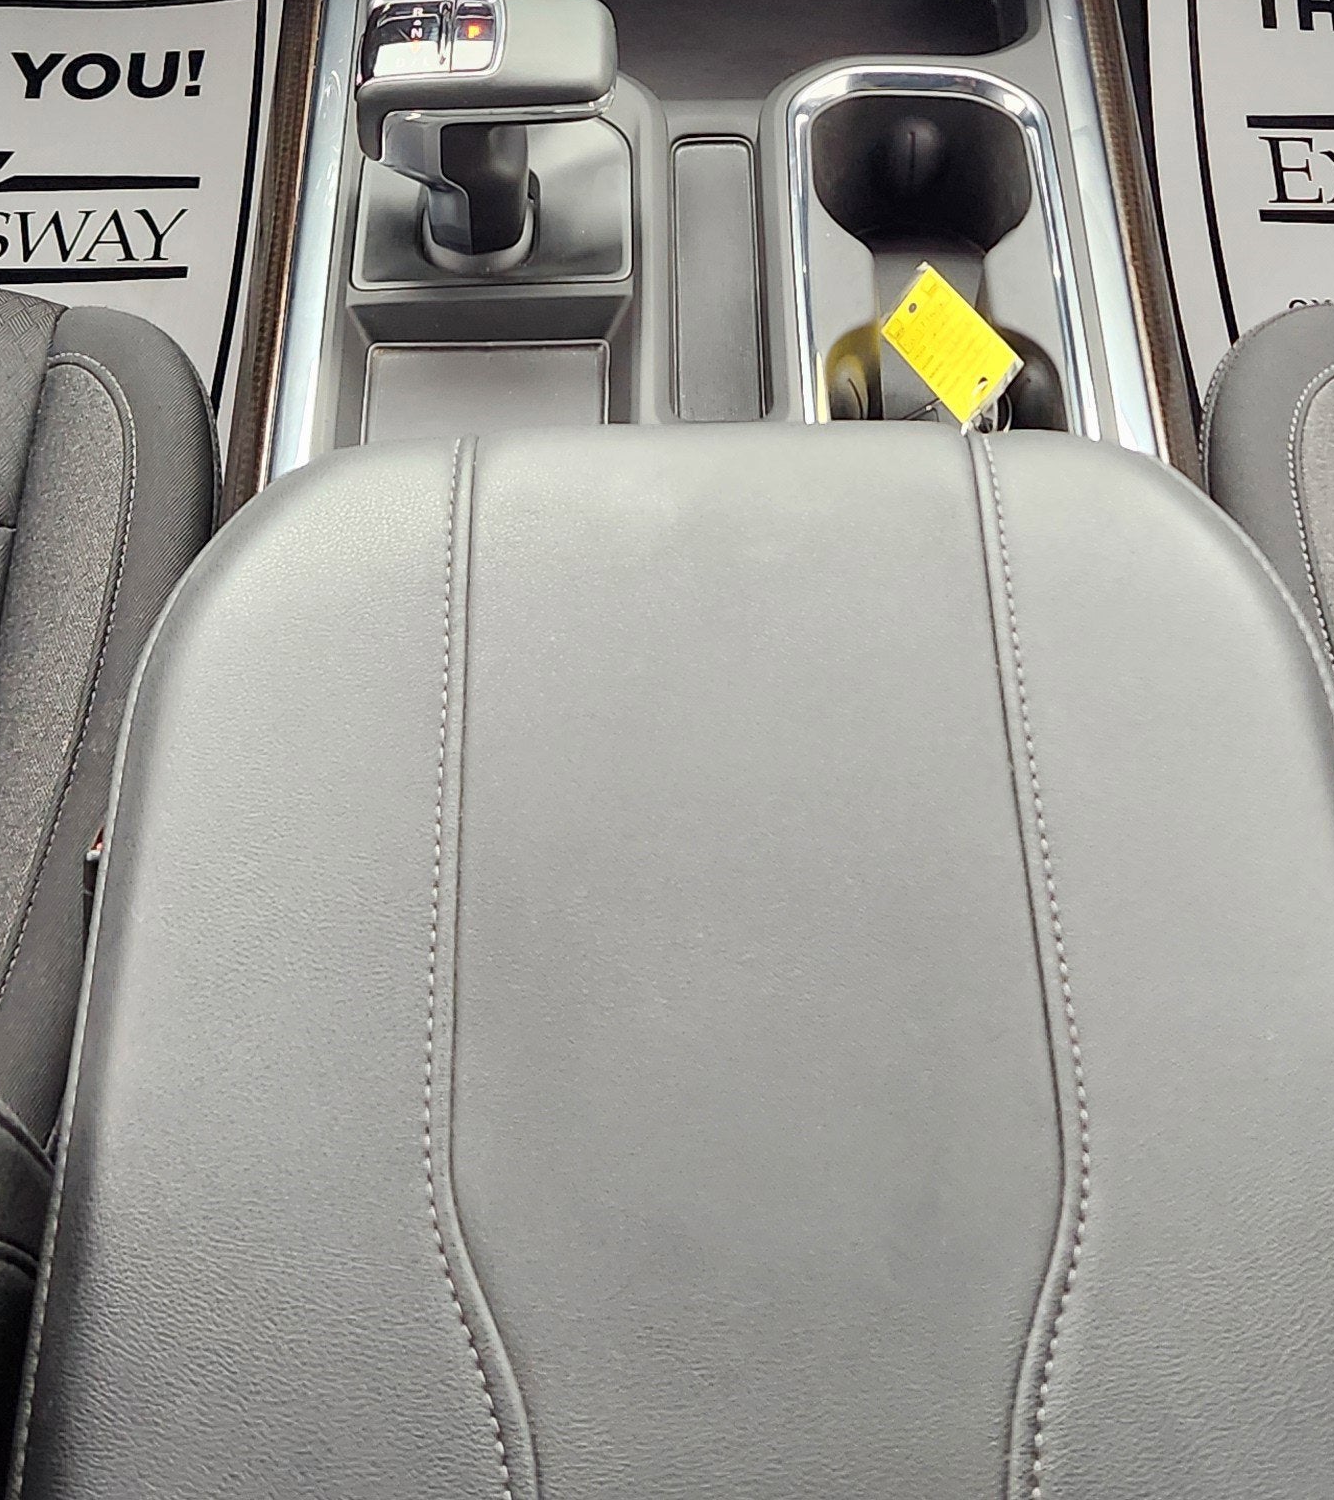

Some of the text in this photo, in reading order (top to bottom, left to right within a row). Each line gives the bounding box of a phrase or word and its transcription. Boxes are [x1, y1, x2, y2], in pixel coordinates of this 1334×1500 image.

[412, 6, 424, 17] R
[410, 27, 423, 39] N
[467, 24, 481, 39] P
[12, 49, 207, 99] YOU!
